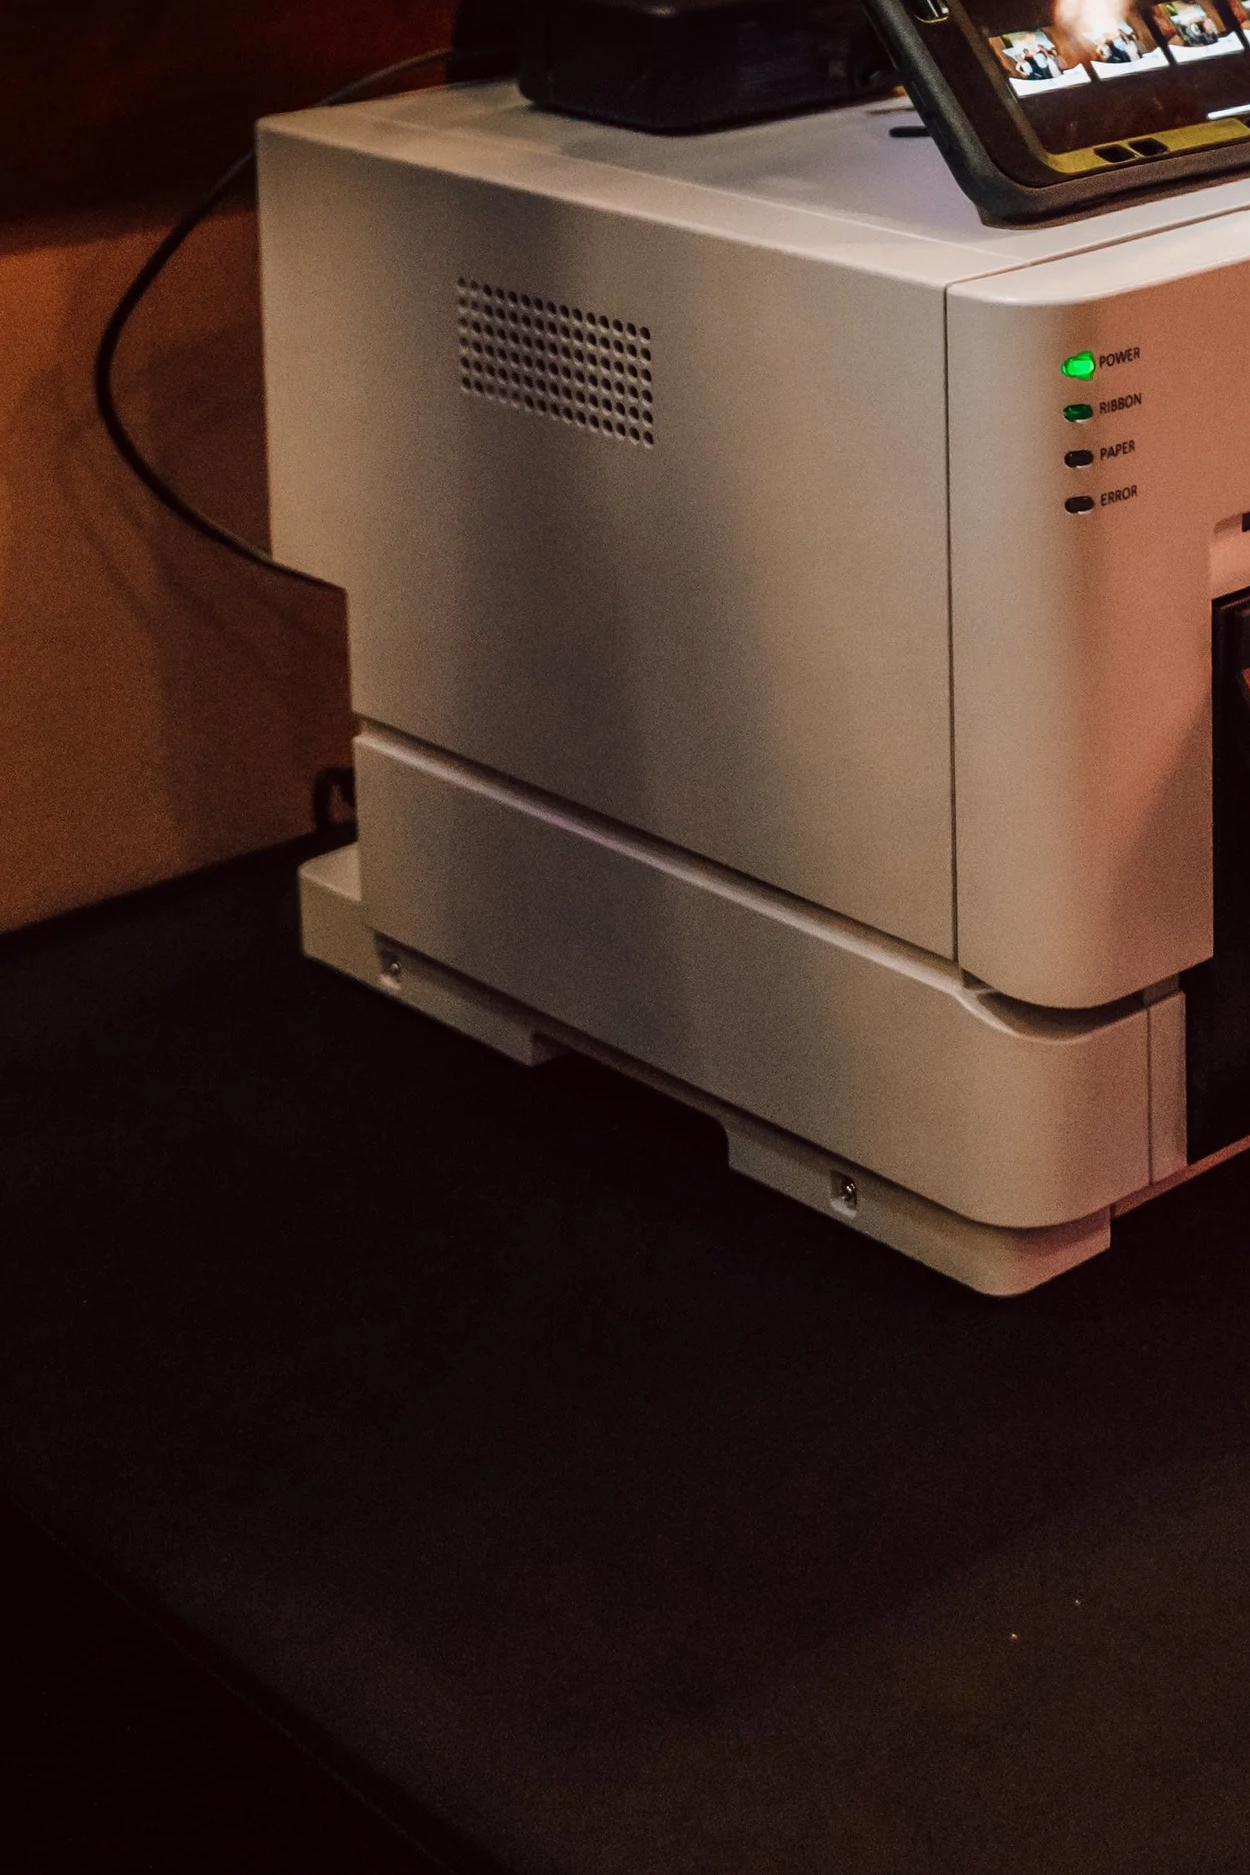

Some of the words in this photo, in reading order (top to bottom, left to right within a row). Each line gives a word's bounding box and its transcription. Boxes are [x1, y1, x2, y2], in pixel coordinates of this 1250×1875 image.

[1099, 346, 1141, 369] POWER
[1099, 392, 1142, 415] RIBBON
[1100, 439, 1136, 462] PAPER
[1100, 484, 1138, 507] ERROR
